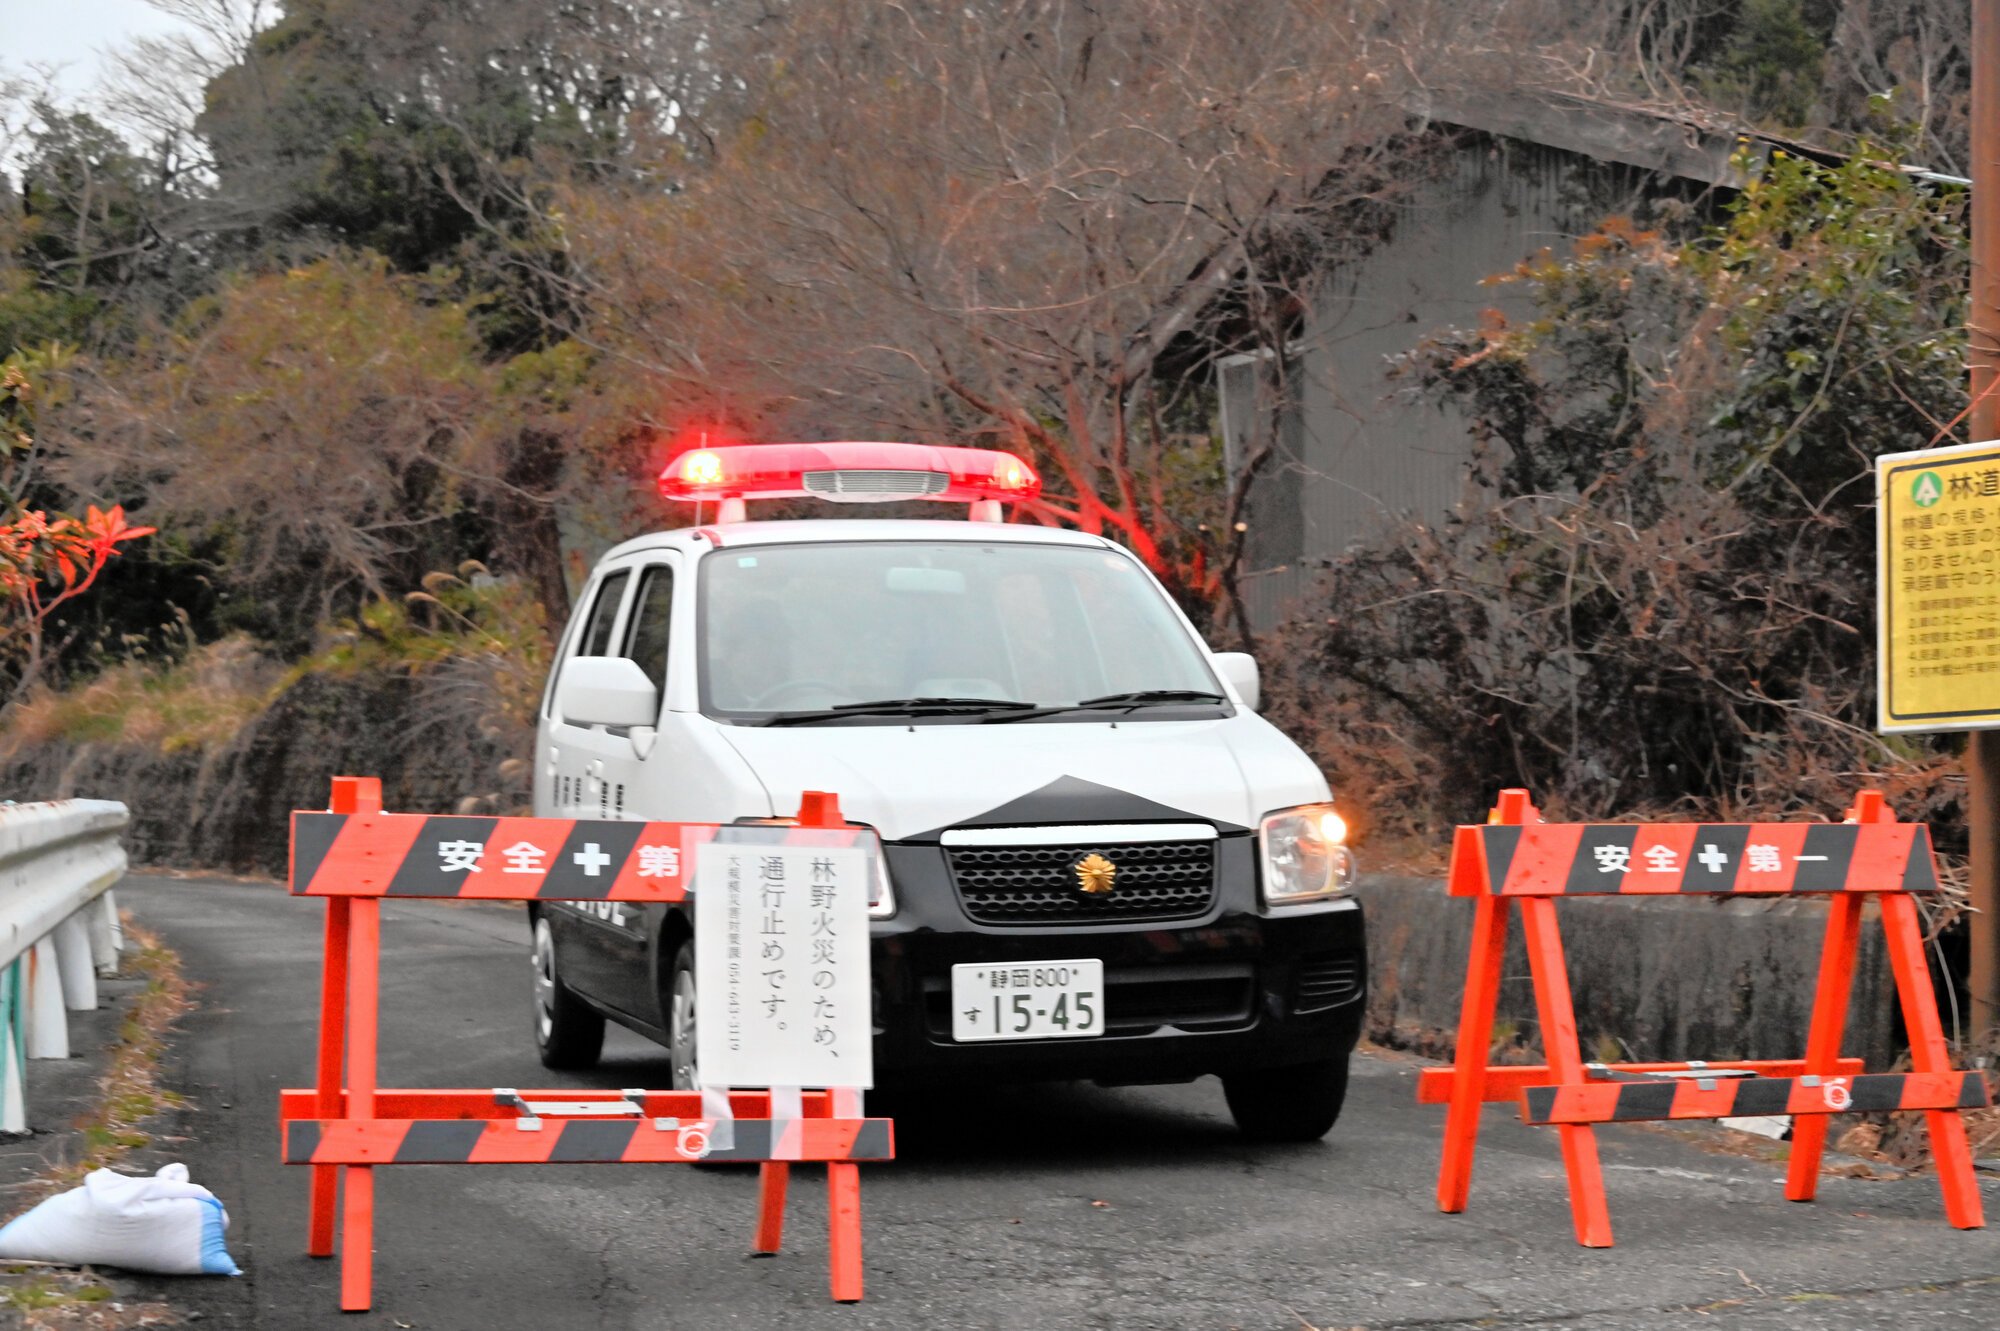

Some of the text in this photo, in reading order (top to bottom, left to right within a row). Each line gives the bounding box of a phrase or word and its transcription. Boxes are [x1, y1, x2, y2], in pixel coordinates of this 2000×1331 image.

[437, 839, 547, 874] 安全
[1593, 843, 1829, 873] 安全 第一
[759, 855, 788, 1031] 通行止めです。
[809, 856, 839, 1058] 林野火災のため、
[994, 992, 1094, 1034] 15-45
